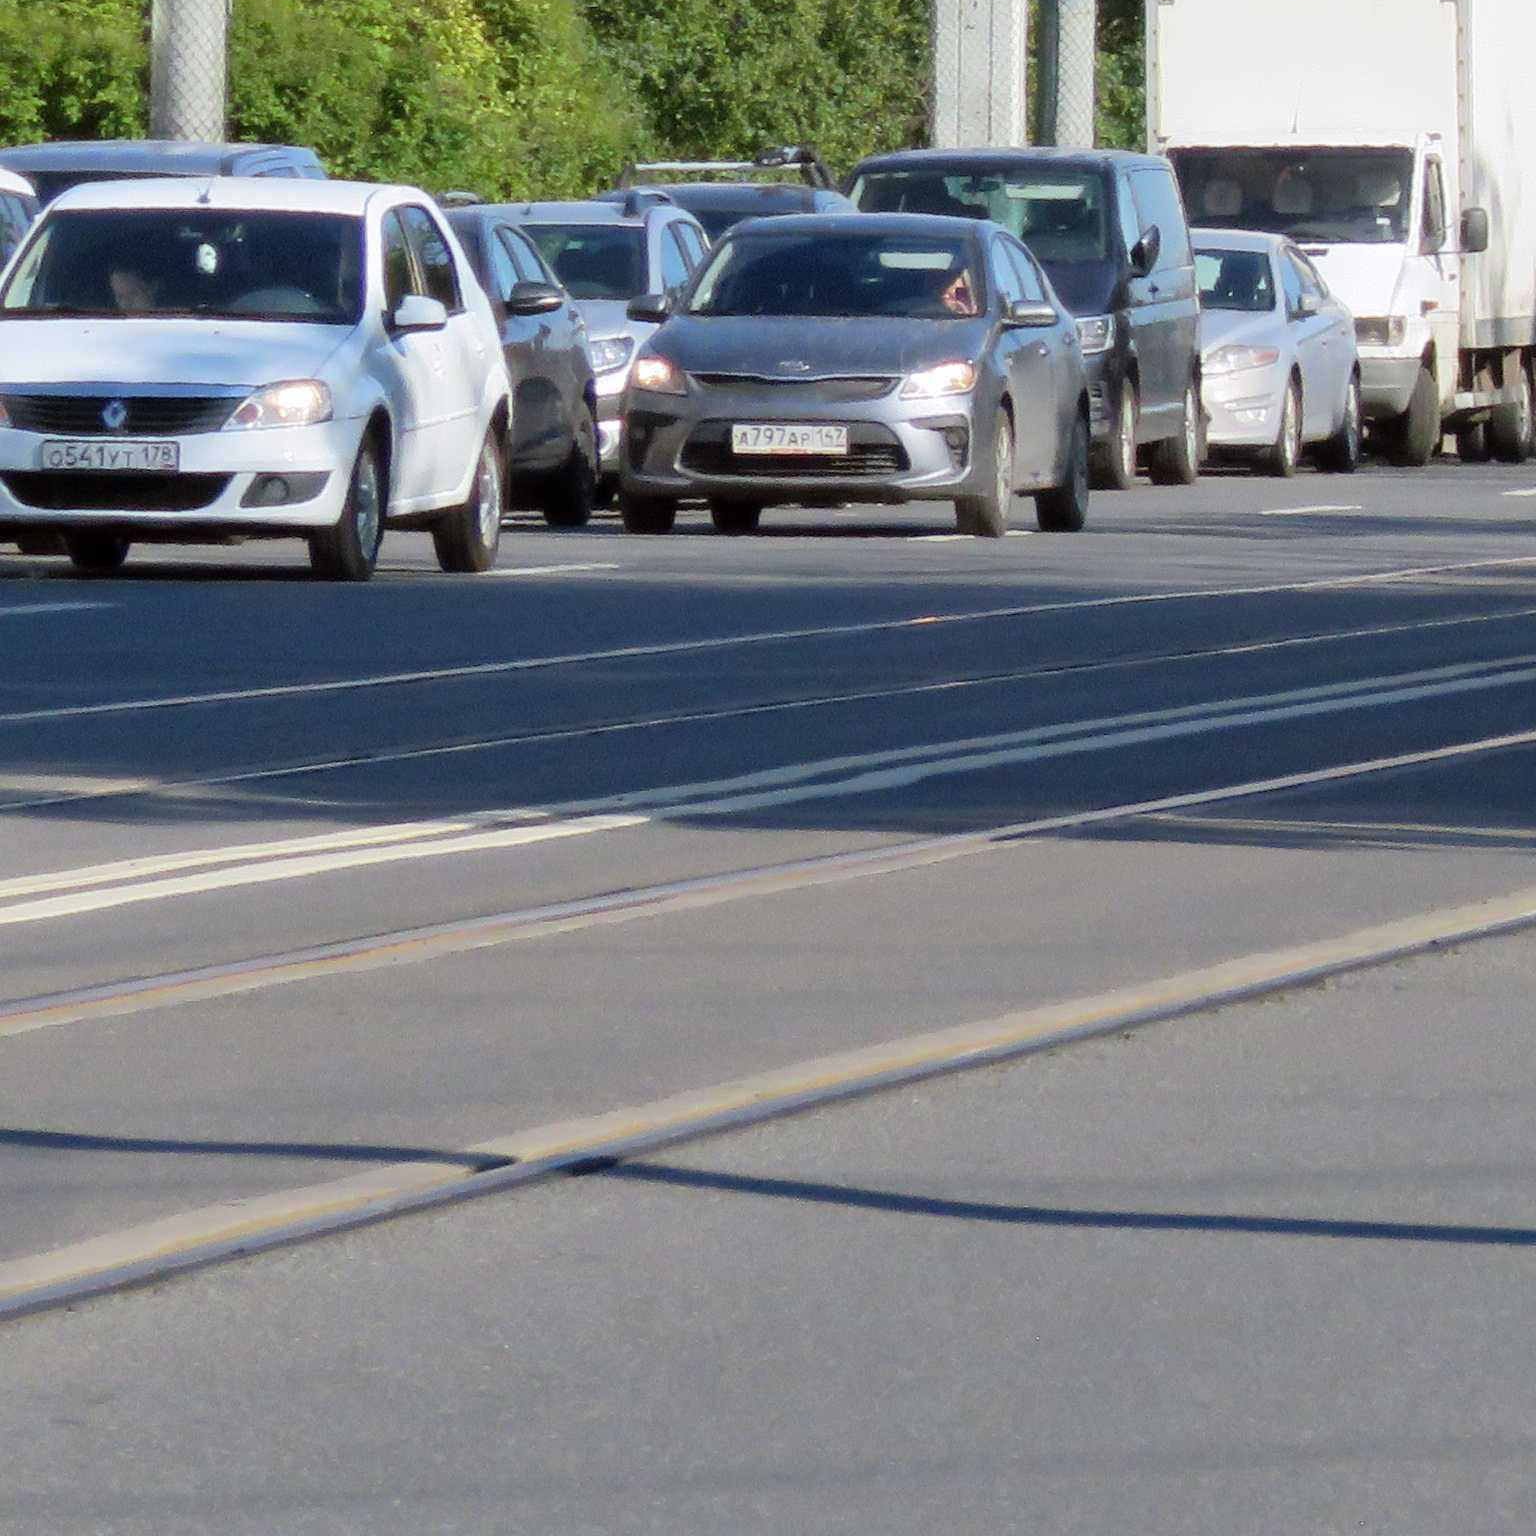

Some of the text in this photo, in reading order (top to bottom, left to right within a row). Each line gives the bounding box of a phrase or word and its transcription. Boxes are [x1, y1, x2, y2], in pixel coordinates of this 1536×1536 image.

[738, 427, 811, 448] А797АР
[50, 445, 173, 467] О541УТ 178
